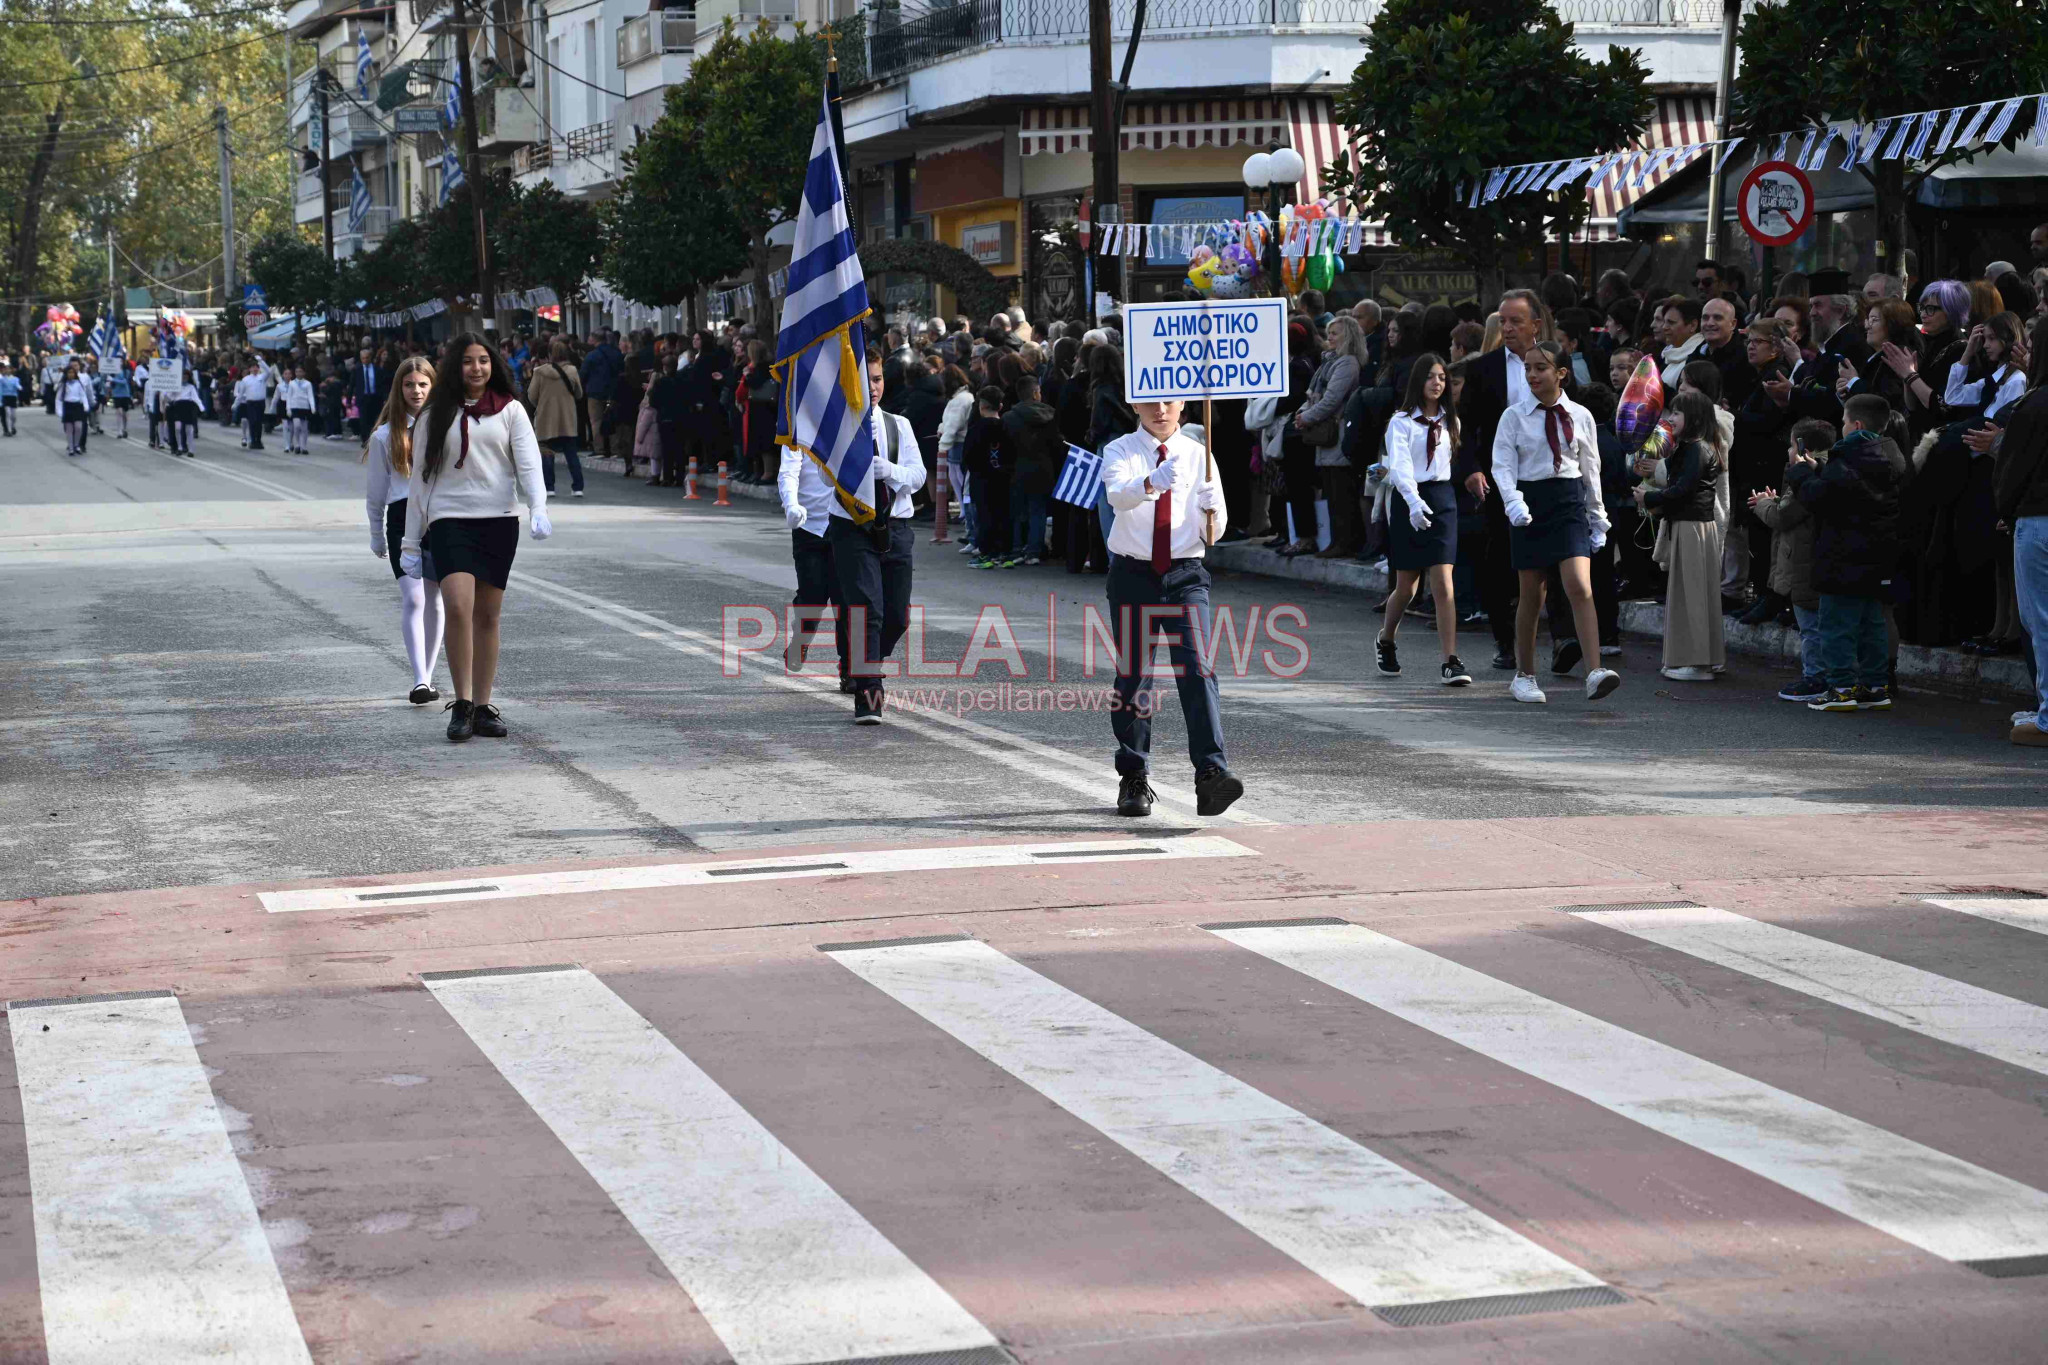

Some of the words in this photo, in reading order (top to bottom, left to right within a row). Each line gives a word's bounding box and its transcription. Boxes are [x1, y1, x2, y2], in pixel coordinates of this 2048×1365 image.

[246, 314, 265, 326] STOP
[1153, 312, 1259, 337] ΔΗΜΟΤΙΚΟ
[1163, 337, 1250, 362] ΣΧΟΛΕΙΟ
[1138, 362, 1277, 391] ΛΙΠΟΧΩΡΙΟΥ
